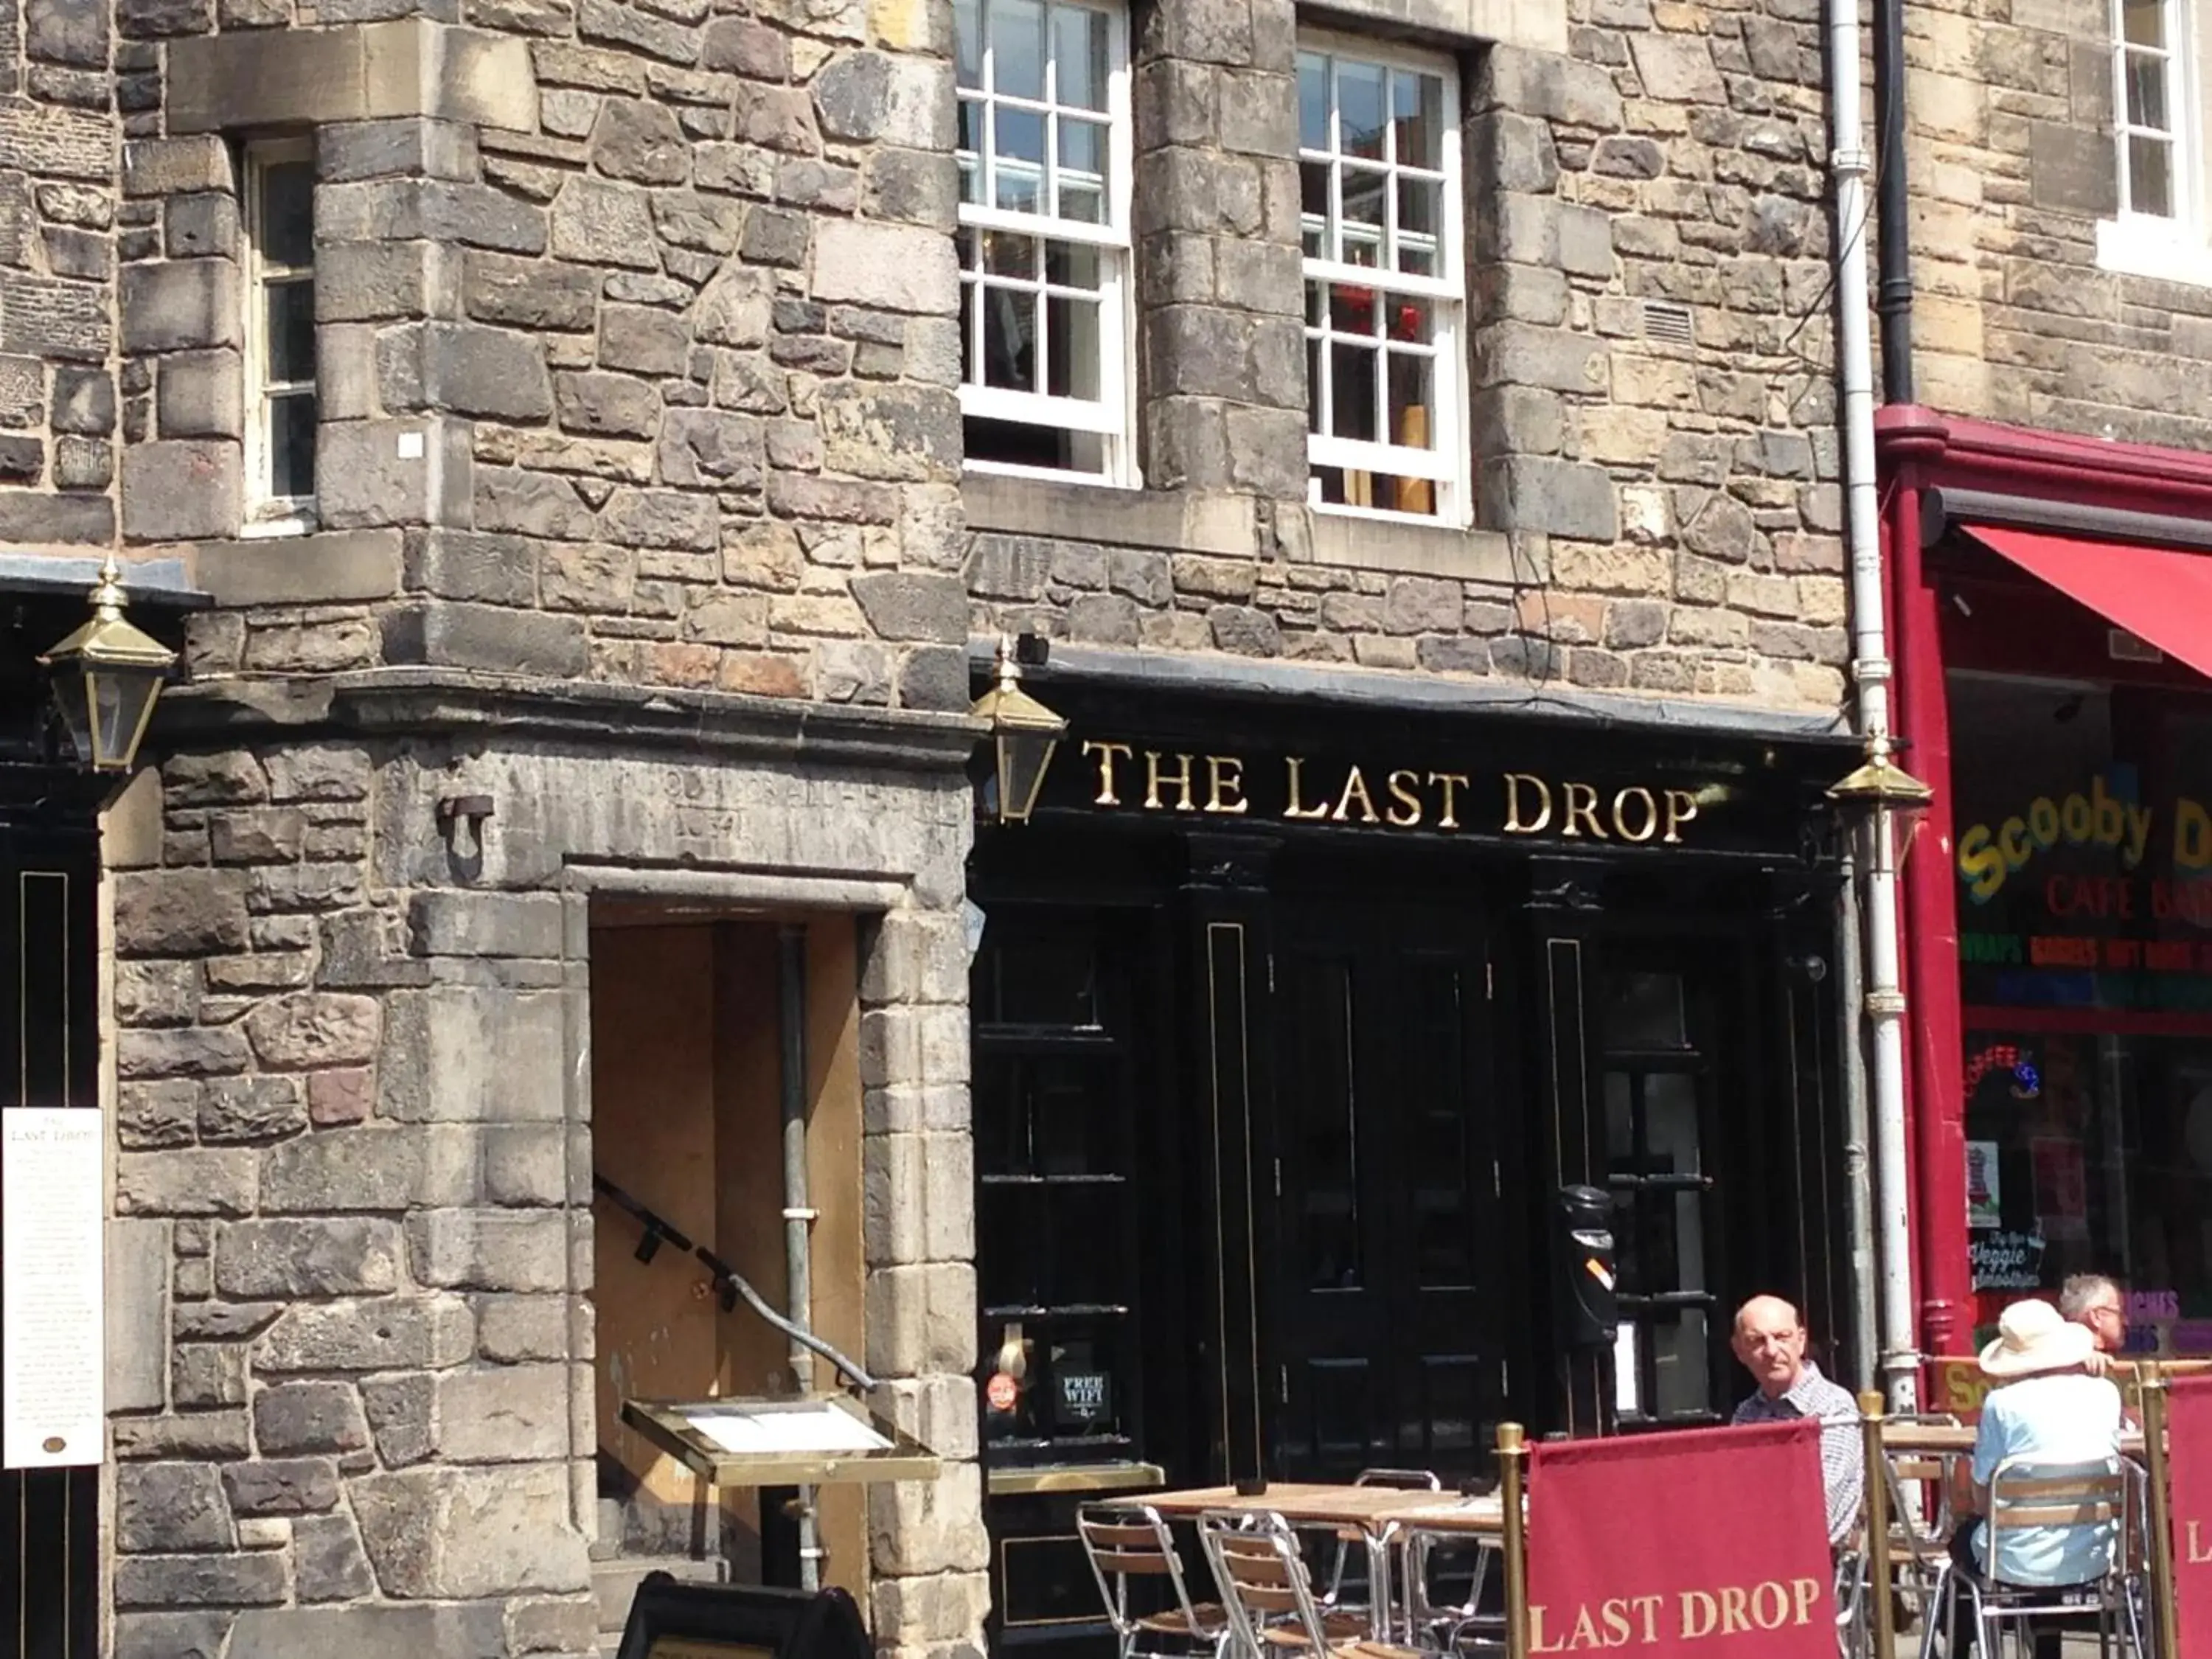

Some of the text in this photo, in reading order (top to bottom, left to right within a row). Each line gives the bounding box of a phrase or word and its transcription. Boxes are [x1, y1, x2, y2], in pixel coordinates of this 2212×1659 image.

[1082, 741, 1699, 844] THE LAST DROP
[1959, 774, 2152, 901] Scooby
[2047, 874, 2135, 918] CAFE
[1063, 1376, 1103, 1389] FREE
[1064, 1389, 1103, 1402] WIFI
[1528, 1578, 1820, 1653] LAST DROP
